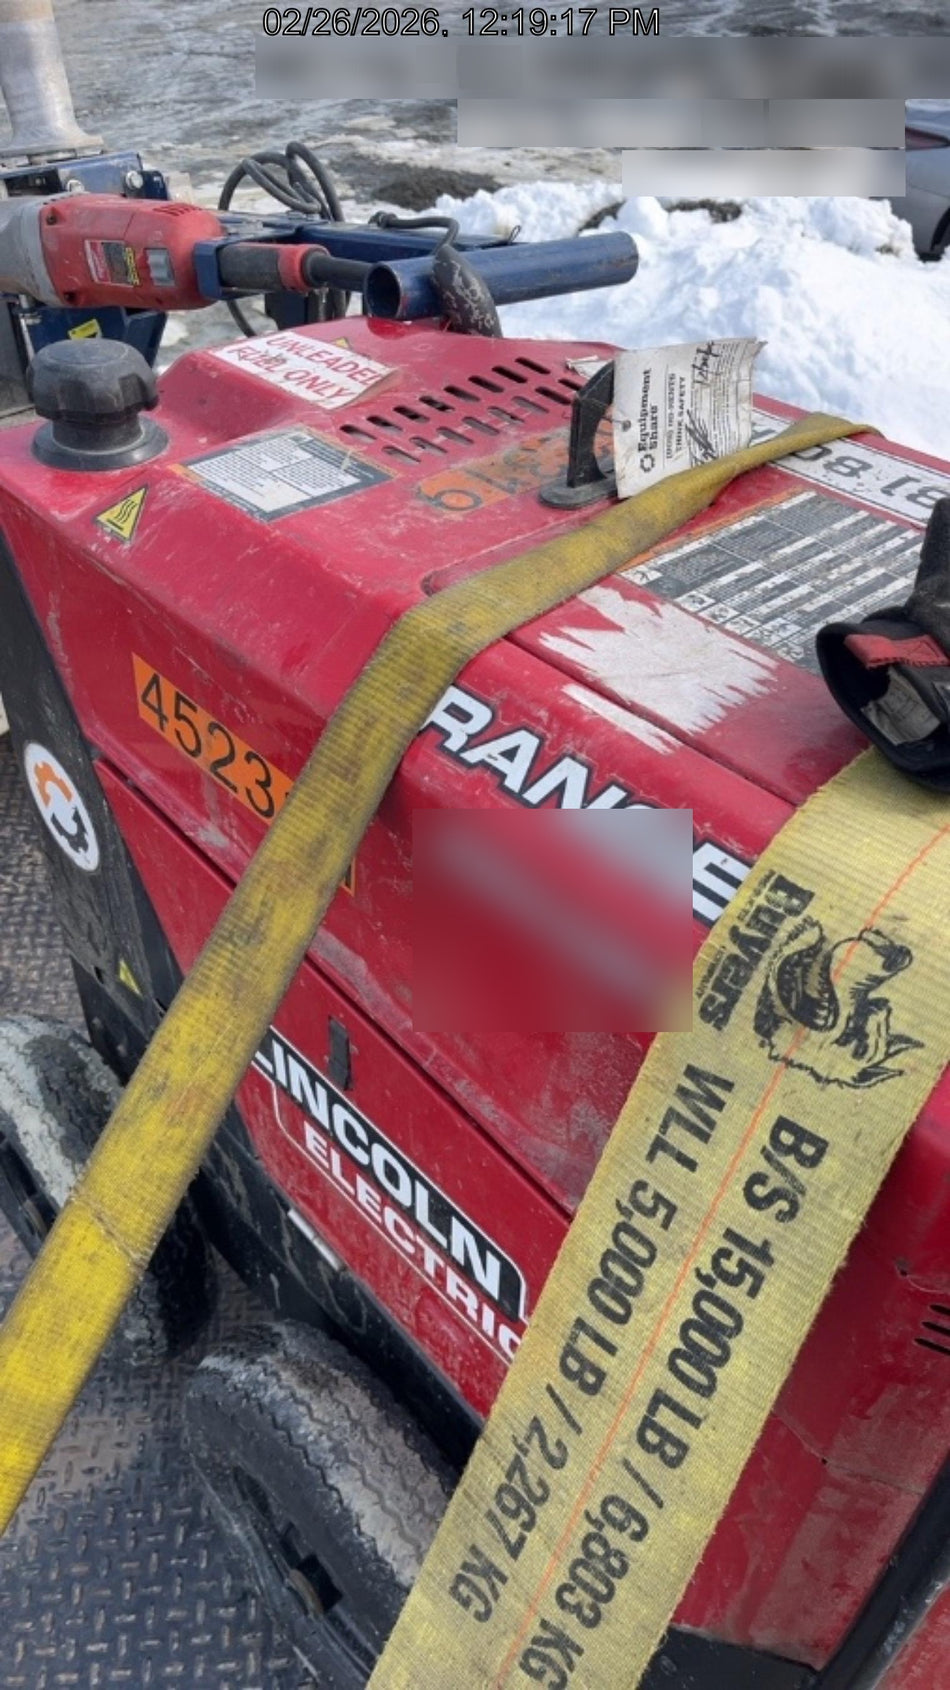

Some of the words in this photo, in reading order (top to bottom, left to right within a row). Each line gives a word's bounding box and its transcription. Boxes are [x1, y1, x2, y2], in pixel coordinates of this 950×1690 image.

[283, 368, 356, 402] ONLY
[637, 367, 652, 453] Equipment
[649, 403, 659, 451] Share
[676, 375, 686, 417] SAFETY
[675, 419, 685, 452] THINK
[140, 672, 290, 820] 4523
[420, 684, 753, 925] RANE
[698, 872, 816, 1032] Buyers
[645, 1062, 736, 1174] WLL
[742, 1115, 830, 1224] B/S
[303, 1120, 523, 1359] ELECTRIC
[585, 1180, 679, 1328] 5,000
[668, 1227, 776, 1402] 15,000
[558, 1324, 619, 1398] LB
[545, 1385, 583, 1436] /
[637, 1387, 703, 1471] LB
[492, 1415, 569, 1564] 2,267
[622, 1458, 665, 1510] /
[449, 1543, 508, 1623] KG
[555, 1491, 650, 1630] 6,803
[518, 1618, 585, 1690] KG
